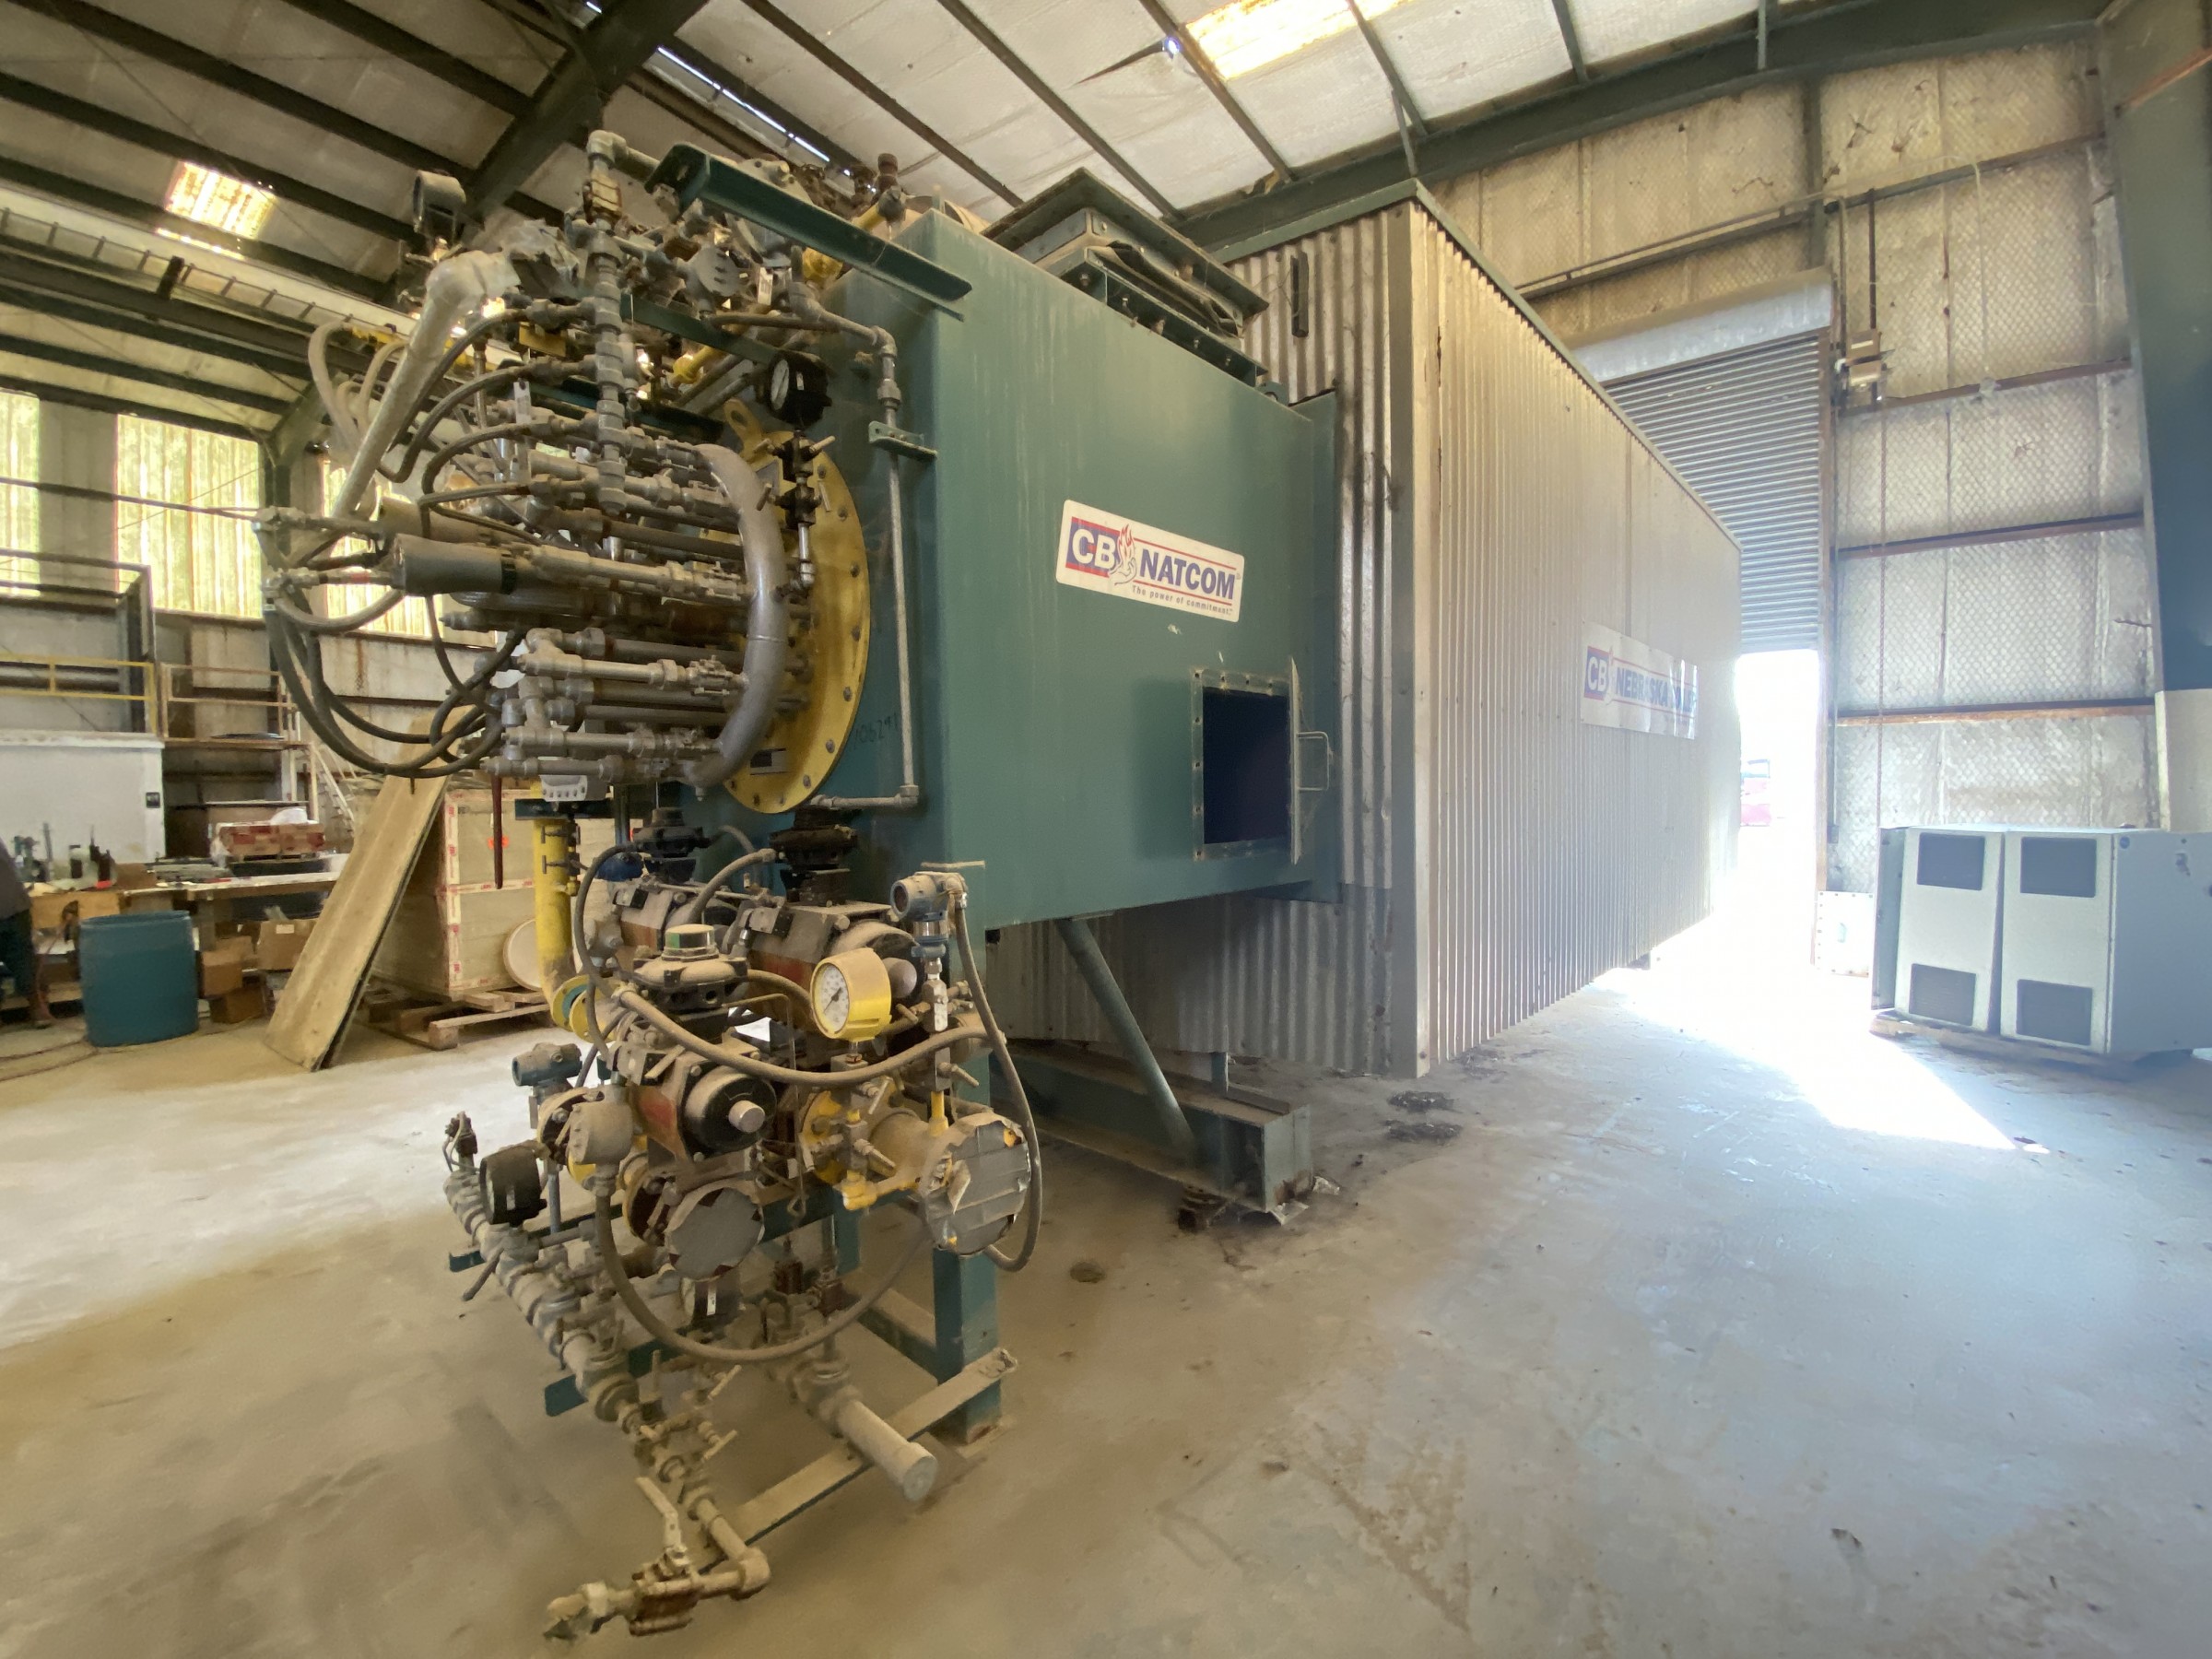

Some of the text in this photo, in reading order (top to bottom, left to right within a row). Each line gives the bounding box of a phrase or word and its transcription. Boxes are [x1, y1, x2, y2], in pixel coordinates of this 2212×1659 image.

[1072, 529, 1235, 600] CB NATCOM
[1132, 584, 1146, 596] The
[1149, 591, 1172, 603] power
[1176, 596, 1184, 605] of
[1587, 655, 1607, 692] CB
